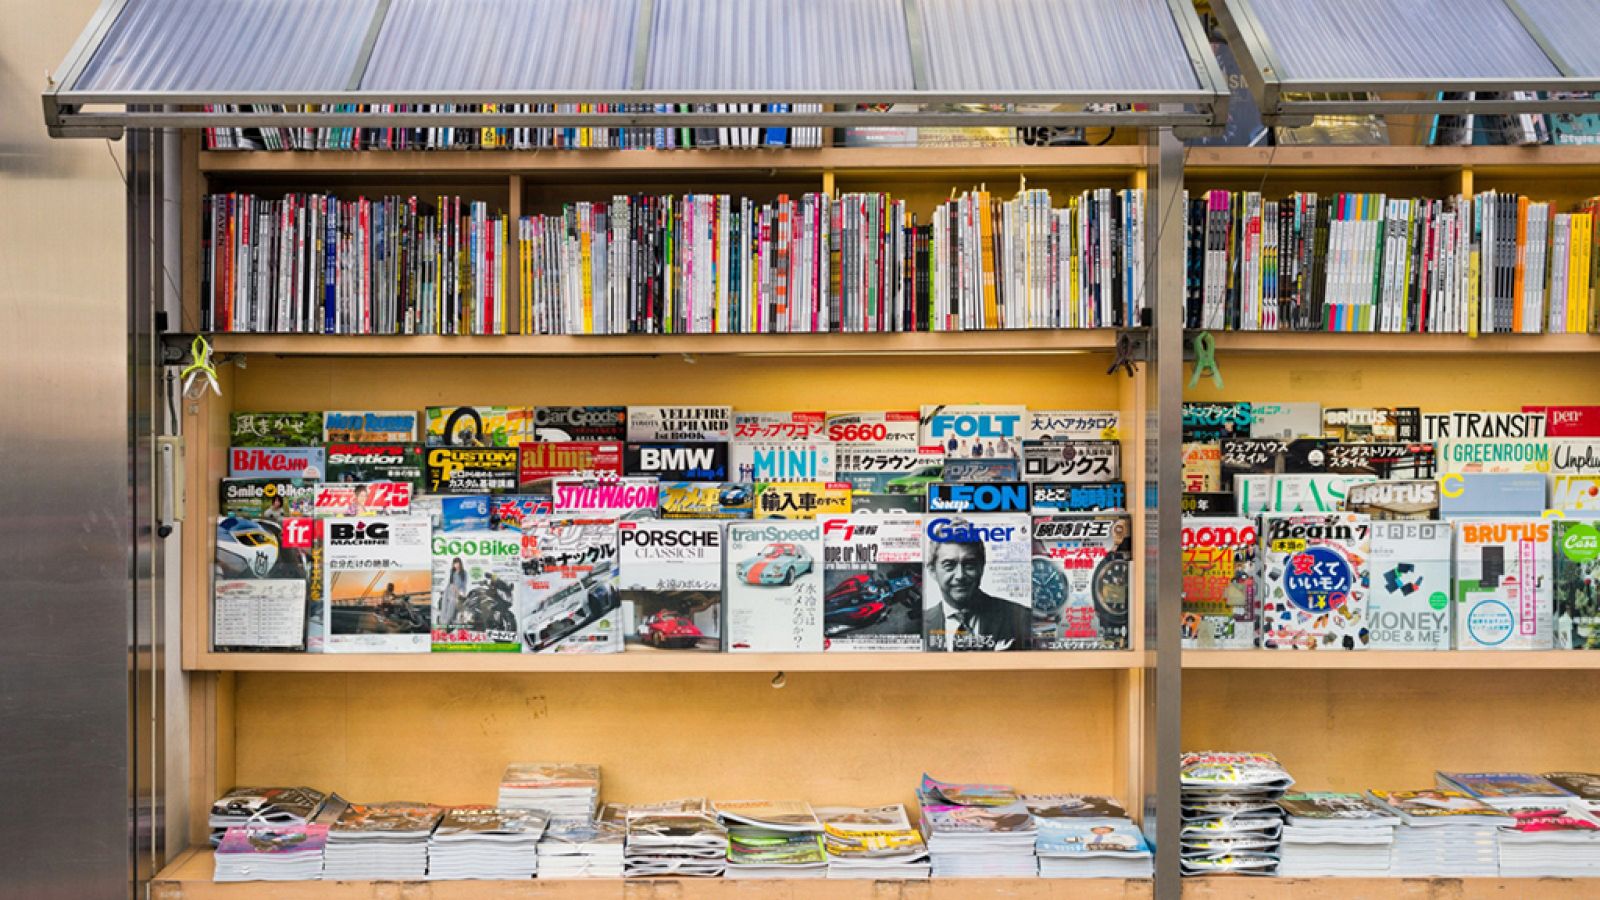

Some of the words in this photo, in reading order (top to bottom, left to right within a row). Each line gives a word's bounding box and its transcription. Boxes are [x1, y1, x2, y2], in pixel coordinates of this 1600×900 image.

[660, 408, 729, 419] VELLFIRE
[1327, 410, 1387, 424] BRUTUS
[660, 420, 729, 431] ALPHARD
[735, 423, 823, 437] ステップワゴン
[931, 415, 1020, 437] FOLT
[1031, 417, 1117, 431] 大人ヘアカタログ
[1453, 414, 1544, 437] TRANSIT
[328, 453, 404, 464] Station
[640, 448, 715, 470] BMW
[1224, 454, 1268, 464] スタイル
[1453, 443, 1549, 462] GREENROOM
[754, 450, 817, 478] MINI
[1025, 457, 1112, 475] ロレックス
[227, 485, 263, 498] Smile
[364, 483, 409, 507] 125
[930, 484, 1027, 511] LEON
[1351, 483, 1436, 503] BRUTUS
[761, 491, 846, 511] 輸入車のすべて
[330, 521, 389, 539] BiG
[621, 530, 719, 546] PORSCHE
[732, 526, 820, 545] tranSpeed
[927, 518, 1015, 543] Gainer
[1274, 520, 1351, 541] Begin
[1463, 523, 1551, 543] BRUTUS
[1564, 534, 1598, 548] Casa
[635, 547, 696, 559] CLASSICS
[330, 560, 404, 569] 自分だけの絶景へ。
[1292, 555, 1340, 575] 安くて
[1289, 576, 1347, 591] いいモノ。
[1370, 630, 1401, 643] ODE
[1404, 630, 1415, 643] &
[1418, 630, 1441, 643] ME
